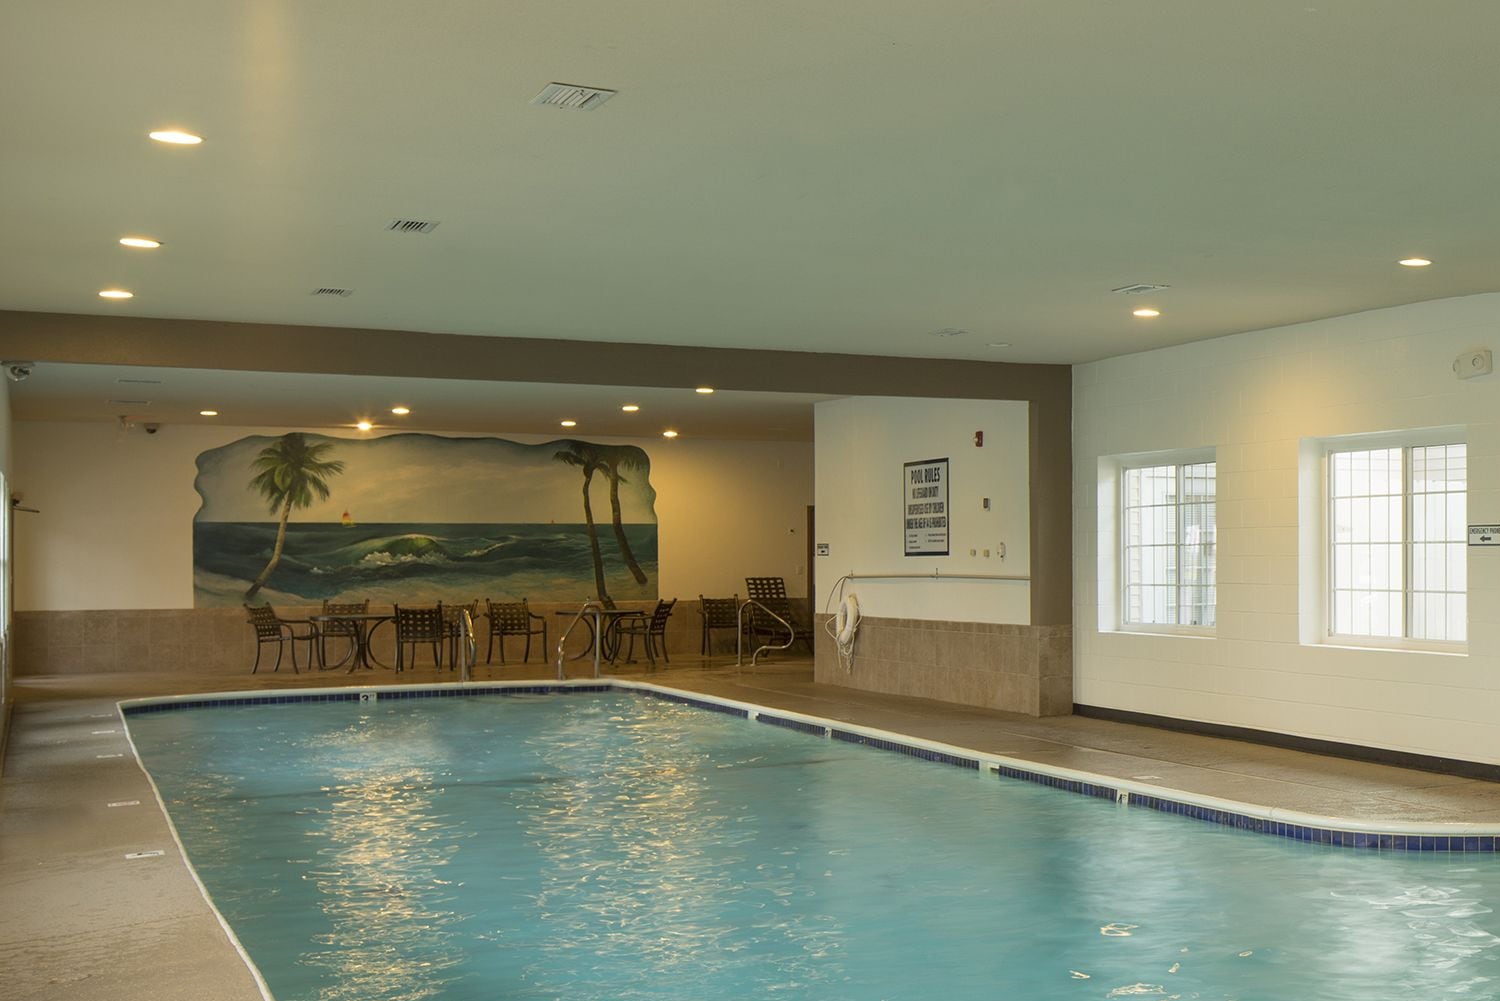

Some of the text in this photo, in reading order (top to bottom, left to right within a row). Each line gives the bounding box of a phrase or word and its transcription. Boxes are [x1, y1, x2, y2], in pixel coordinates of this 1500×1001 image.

[910, 467, 940, 484] POOL RULES
[1469, 527, 1489, 535] EMERGENCY
